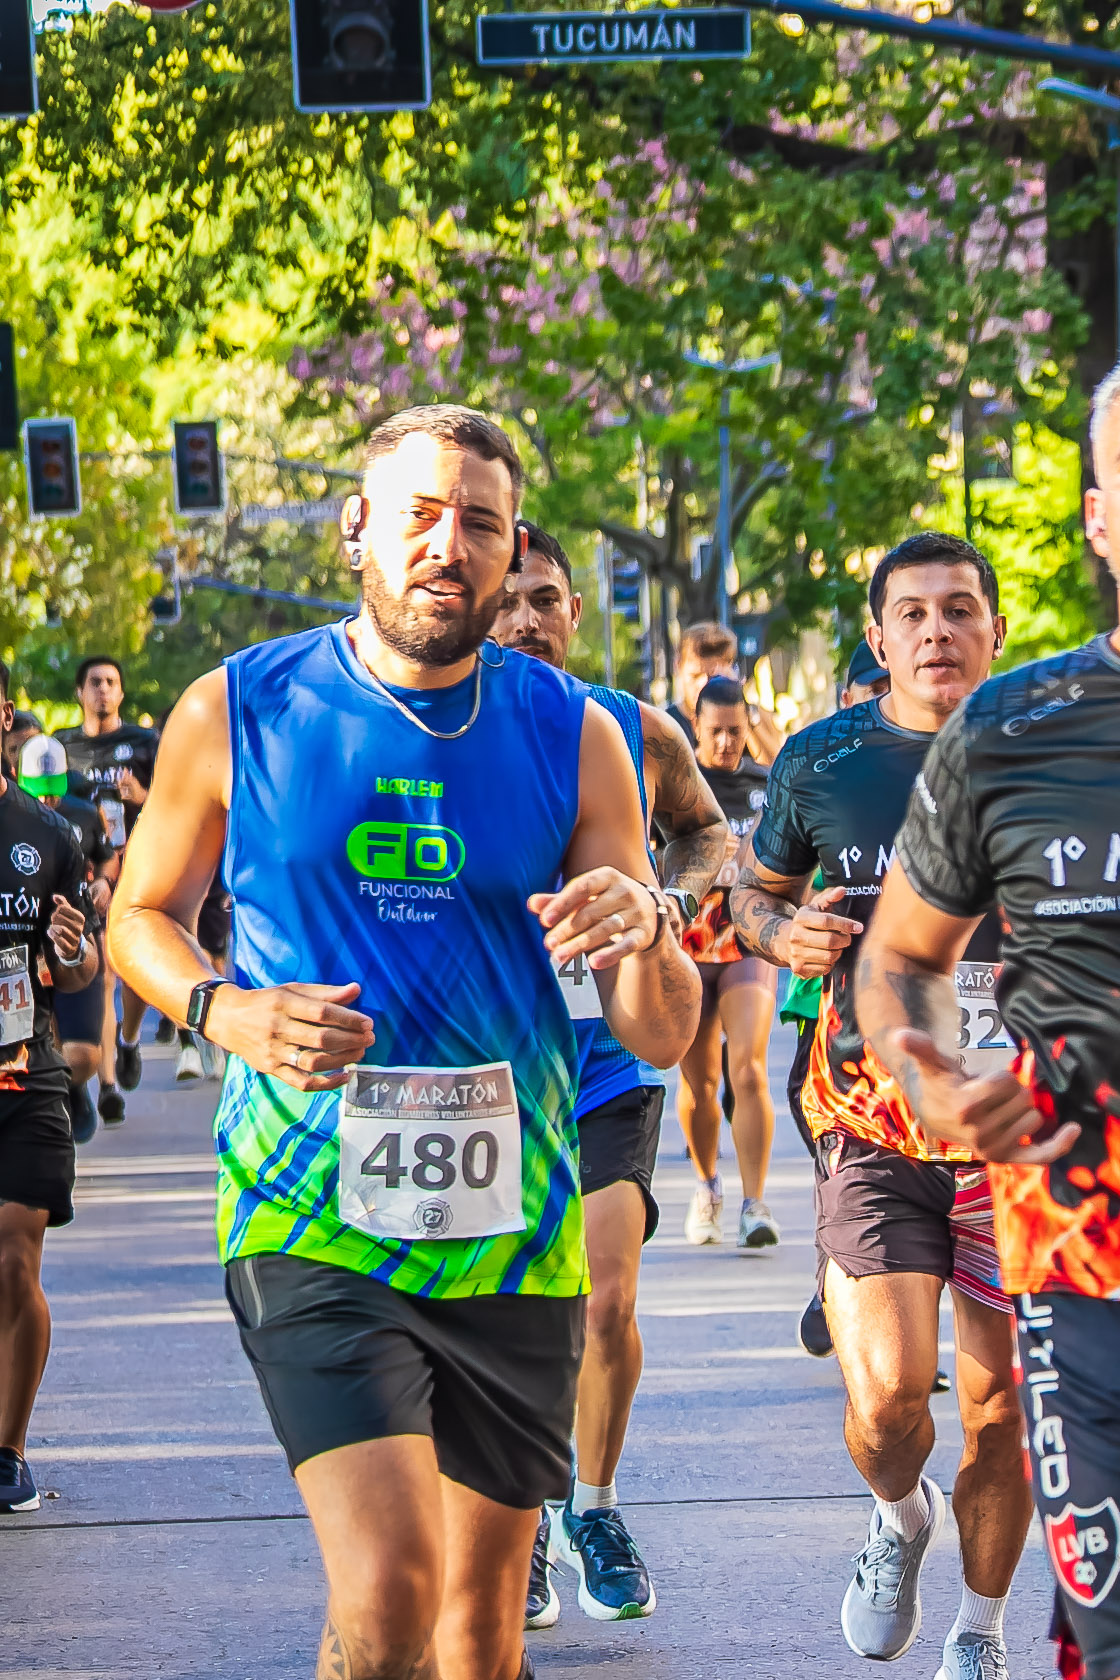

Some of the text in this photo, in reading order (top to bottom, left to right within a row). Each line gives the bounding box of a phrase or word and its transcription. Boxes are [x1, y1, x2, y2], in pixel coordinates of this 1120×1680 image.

[532, 14, 696, 52] TUCUMÁN
[375, 777, 443, 797] HARLEM
[0, 887, 39, 917] TÓN
[359, 882, 455, 900] FUNCIONAL
[954, 968, 995, 989] RATÓ
[395, 1077, 498, 1106] MARATÓN
[360, 1131, 499, 1191] 480
